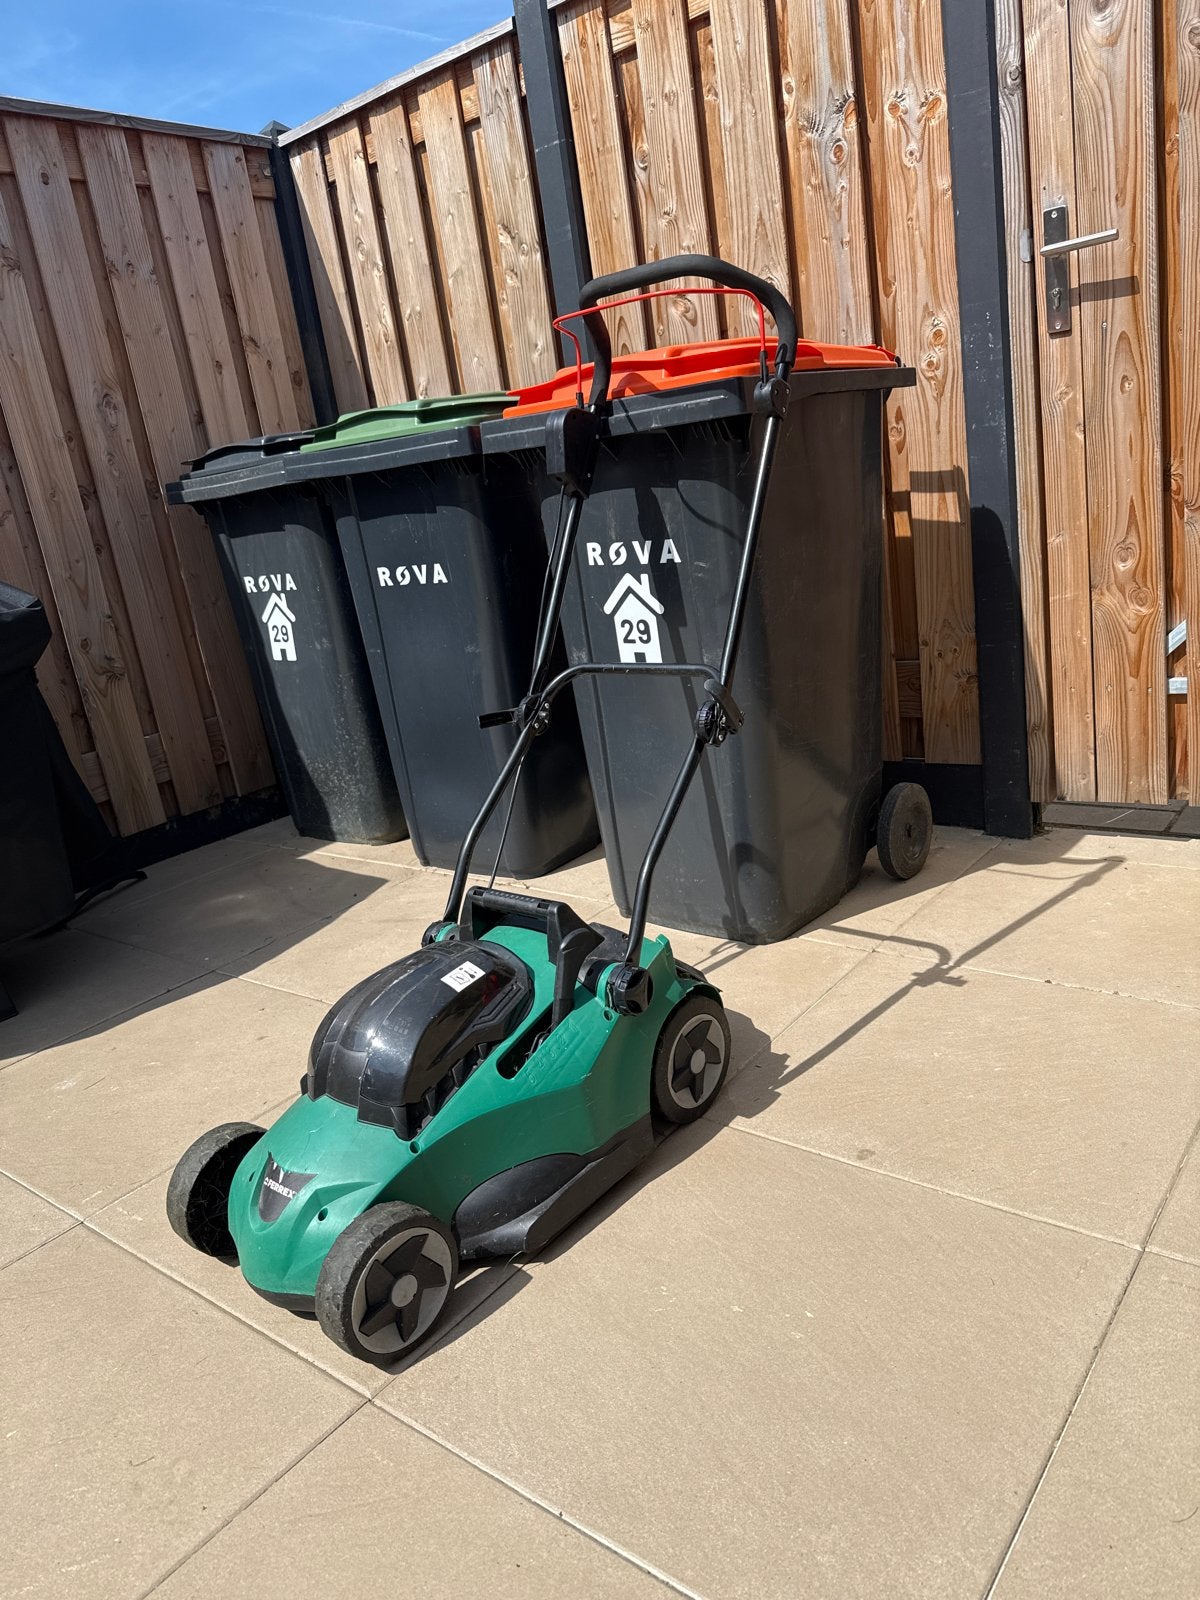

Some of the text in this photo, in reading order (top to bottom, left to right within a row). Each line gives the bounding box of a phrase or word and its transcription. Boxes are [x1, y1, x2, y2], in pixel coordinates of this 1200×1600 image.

[271, 624, 289, 643] 29
[620, 619, 652, 644] 29
[266, 1179, 296, 1200] FERREX
